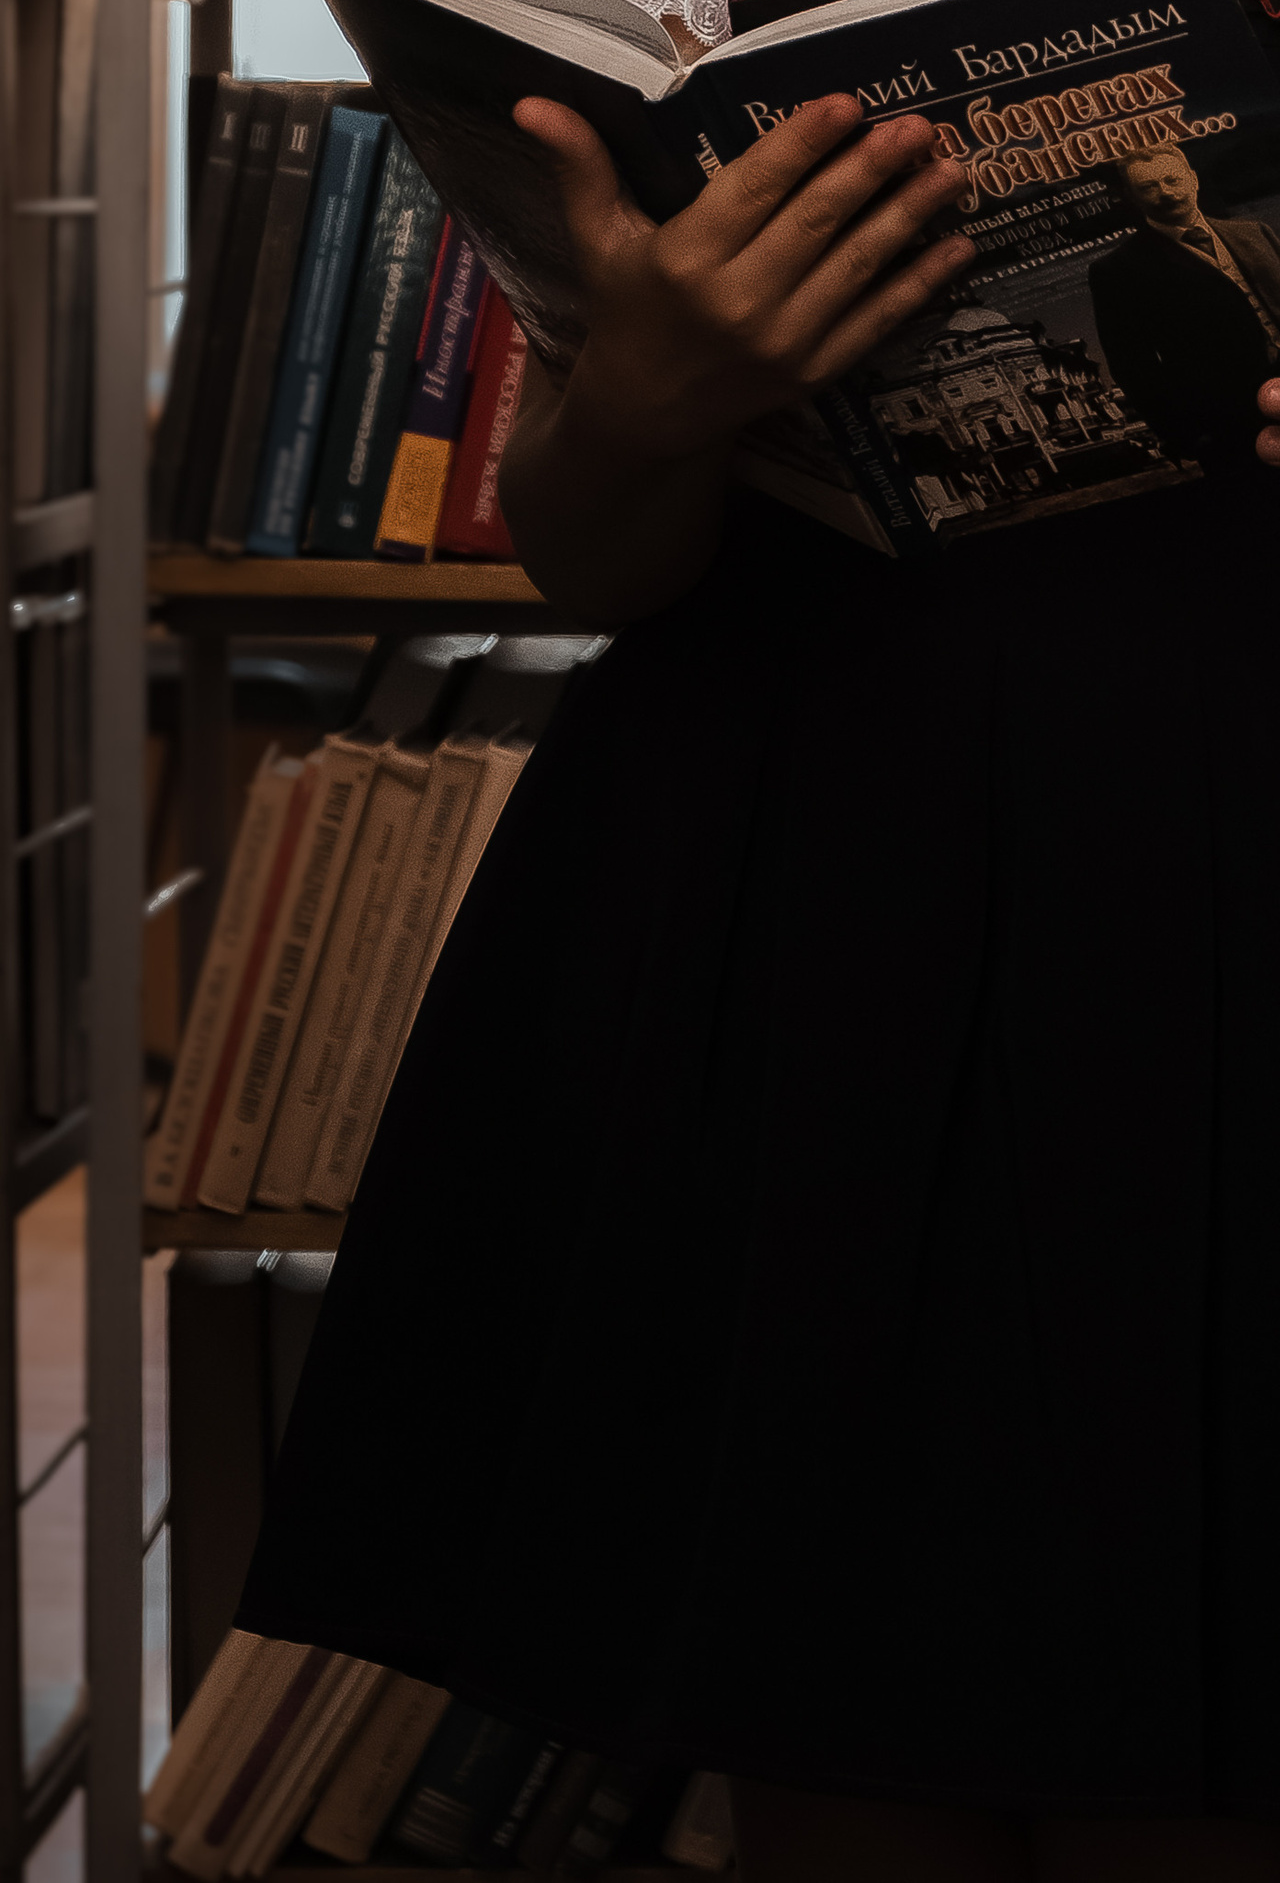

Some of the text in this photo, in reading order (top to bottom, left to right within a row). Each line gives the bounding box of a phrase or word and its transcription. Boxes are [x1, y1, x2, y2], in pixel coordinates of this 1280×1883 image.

[743, 2, 1188, 137] Вилий Бардадым
[969, 63, 1187, 148] берегах
[955, 104, 1238, 212] убанских...
[348, 350, 385, 484] СОВРЕМЕННЫЙ
[375, 262, 403, 345] РУССКИЙ
[859, 459, 912, 530] Виталий
[269, 942, 305, 1010] РУССКИЙ
